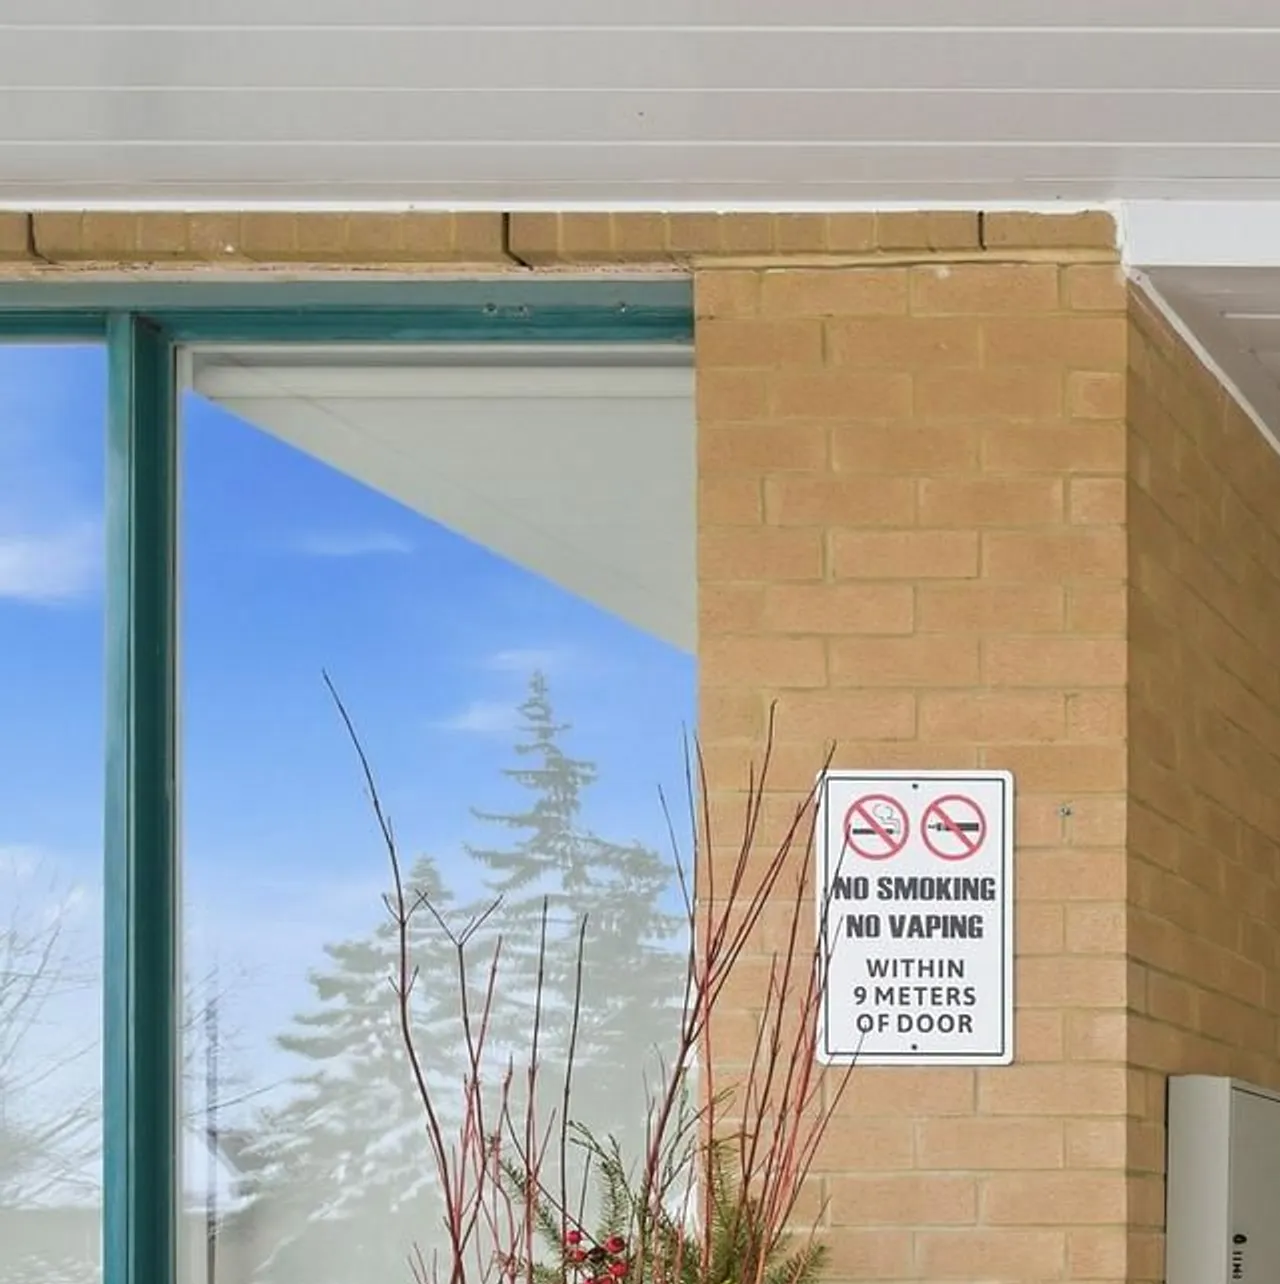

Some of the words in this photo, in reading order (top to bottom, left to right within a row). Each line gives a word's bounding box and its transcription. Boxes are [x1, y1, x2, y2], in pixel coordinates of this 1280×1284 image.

[834, 876, 869, 901] NO
[876, 876, 996, 901] SMOKING
[846, 914, 880, 939] NO
[888, 914, 984, 939] VAPING
[866, 959, 965, 978] WITHIN
[854, 986, 866, 1006] 9
[874, 986, 977, 1006] METERS
[856, 1013, 889, 1033] OF
[898, 1013, 974, 1033] DOOR
